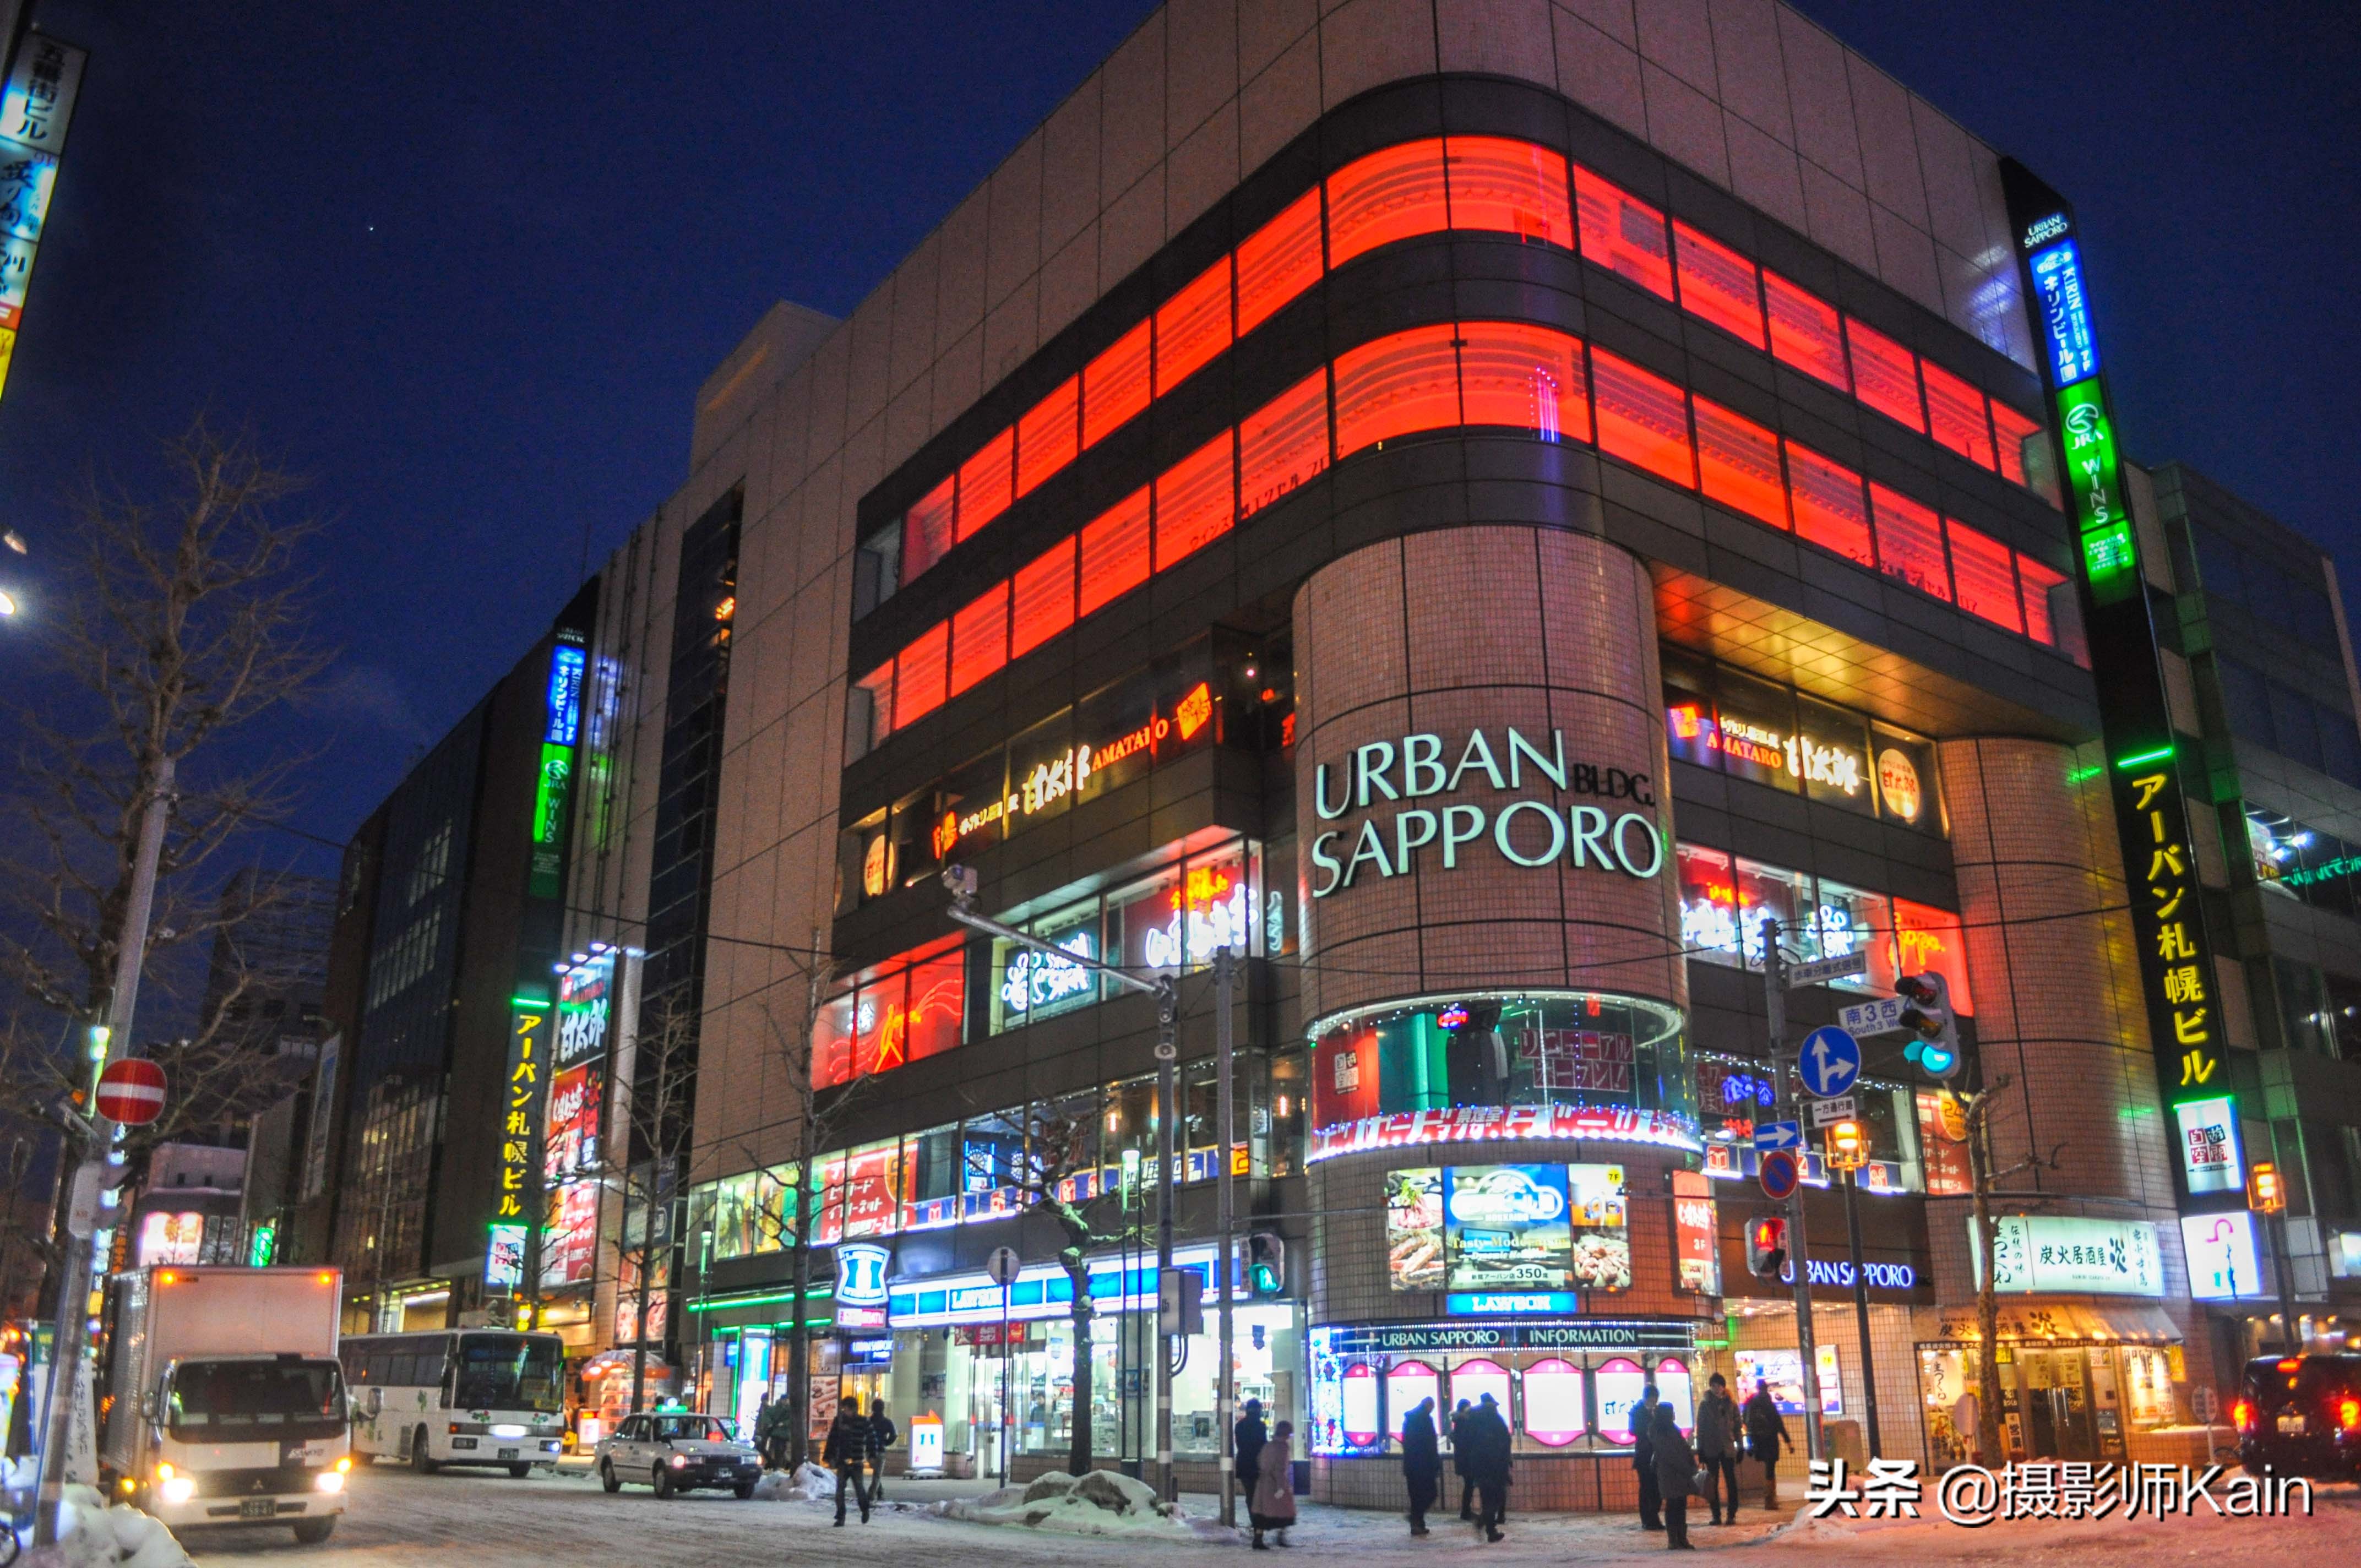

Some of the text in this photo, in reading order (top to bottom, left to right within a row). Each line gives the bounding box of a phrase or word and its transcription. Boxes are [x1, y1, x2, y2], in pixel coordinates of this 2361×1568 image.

[2024, 222, 2068, 248] SAPPORO
[2028, 215, 2061, 236] URBAN
[2063, 266, 2081, 310] KIRIN
[2071, 428, 2104, 449] JRA
[2081, 455, 2108, 524] WINS
[1315, 726, 1568, 820] URBAN
[545, 797, 560, 843] WINS
[1312, 800, 1663, 899] SAPPORO
[2132, 772, 2216, 1087] アーバン札幌ビル
[1848, 1021, 1876, 1036] South
[1876, 1021, 1884, 1031] 3
[1522, 1030, 1631, 1060] リニューアル
[499, 1014, 542, 1217] アーバン札幌ビル
[2188, 1124, 2226, 1145] 自遊
[2191, 1145, 2228, 1164] 空間
[1608, 1173, 1619, 1181] 7F
[1693, 1238, 1706, 1250] 3F
[2039, 1244, 2107, 1266] 炭火居酒屋
[1780, 1259, 1838, 1283] UBAN
[1381, 1329, 1636, 1346] URBAN SAPPORO INFORMATION
[1939, 1321, 2028, 1338] 炭火酒屋
